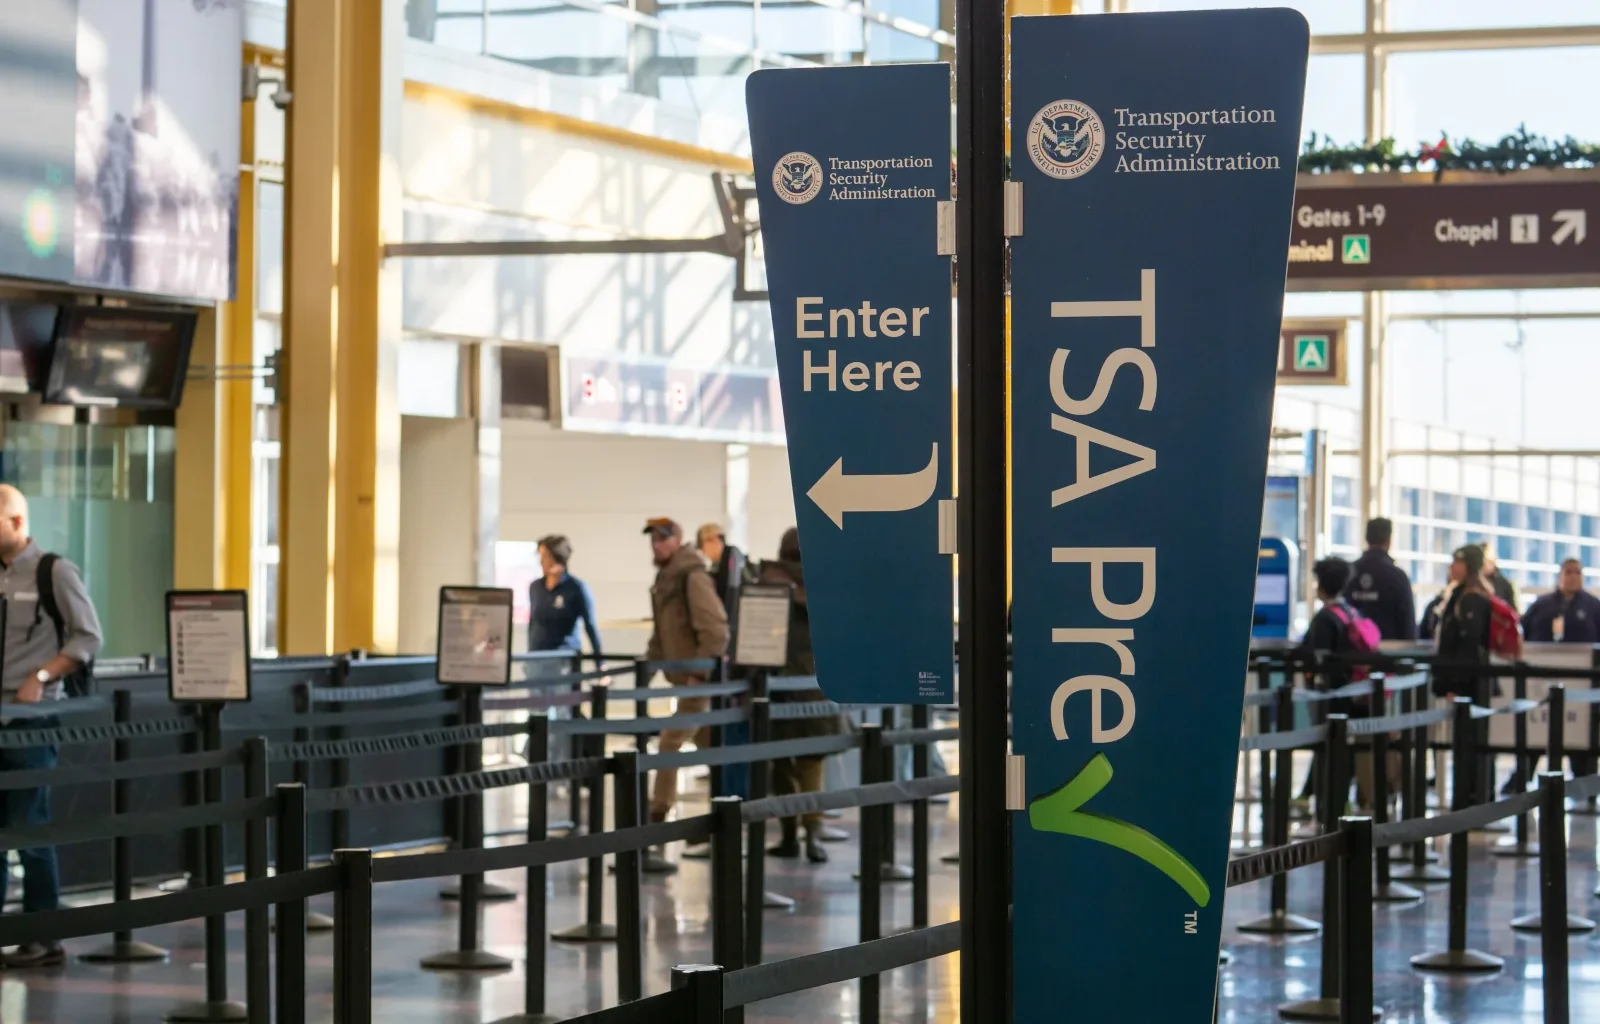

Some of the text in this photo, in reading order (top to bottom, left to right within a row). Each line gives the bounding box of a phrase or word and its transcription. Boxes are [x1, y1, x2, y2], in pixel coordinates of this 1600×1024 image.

[1043, 103, 1096, 122] DEPARTMENT
[1092, 122, 1101, 133] OF
[1114, 106, 1276, 131] Transportation
[1115, 131, 1206, 153] Security
[829, 156, 933, 172] Transportation
[1031, 142, 1101, 176] HOMELAND SECURITY
[1114, 152, 1280, 173] Administration
[800, 179, 821, 201] SECURITY
[829, 172, 888, 188] Security
[829, 186, 936, 200] Administration
[1297, 203, 1386, 228] Gates 1-9
[1435, 217, 1499, 247] Chapel
[1288, 237, 1367, 262] minal A
[796, 296, 930, 339] Enter
[1299, 340, 1325, 368] A
[803, 349, 922, 392] Here
[1049, 268, 1158, 744] TSA Pre
[1184, 911, 1197, 934] TM
